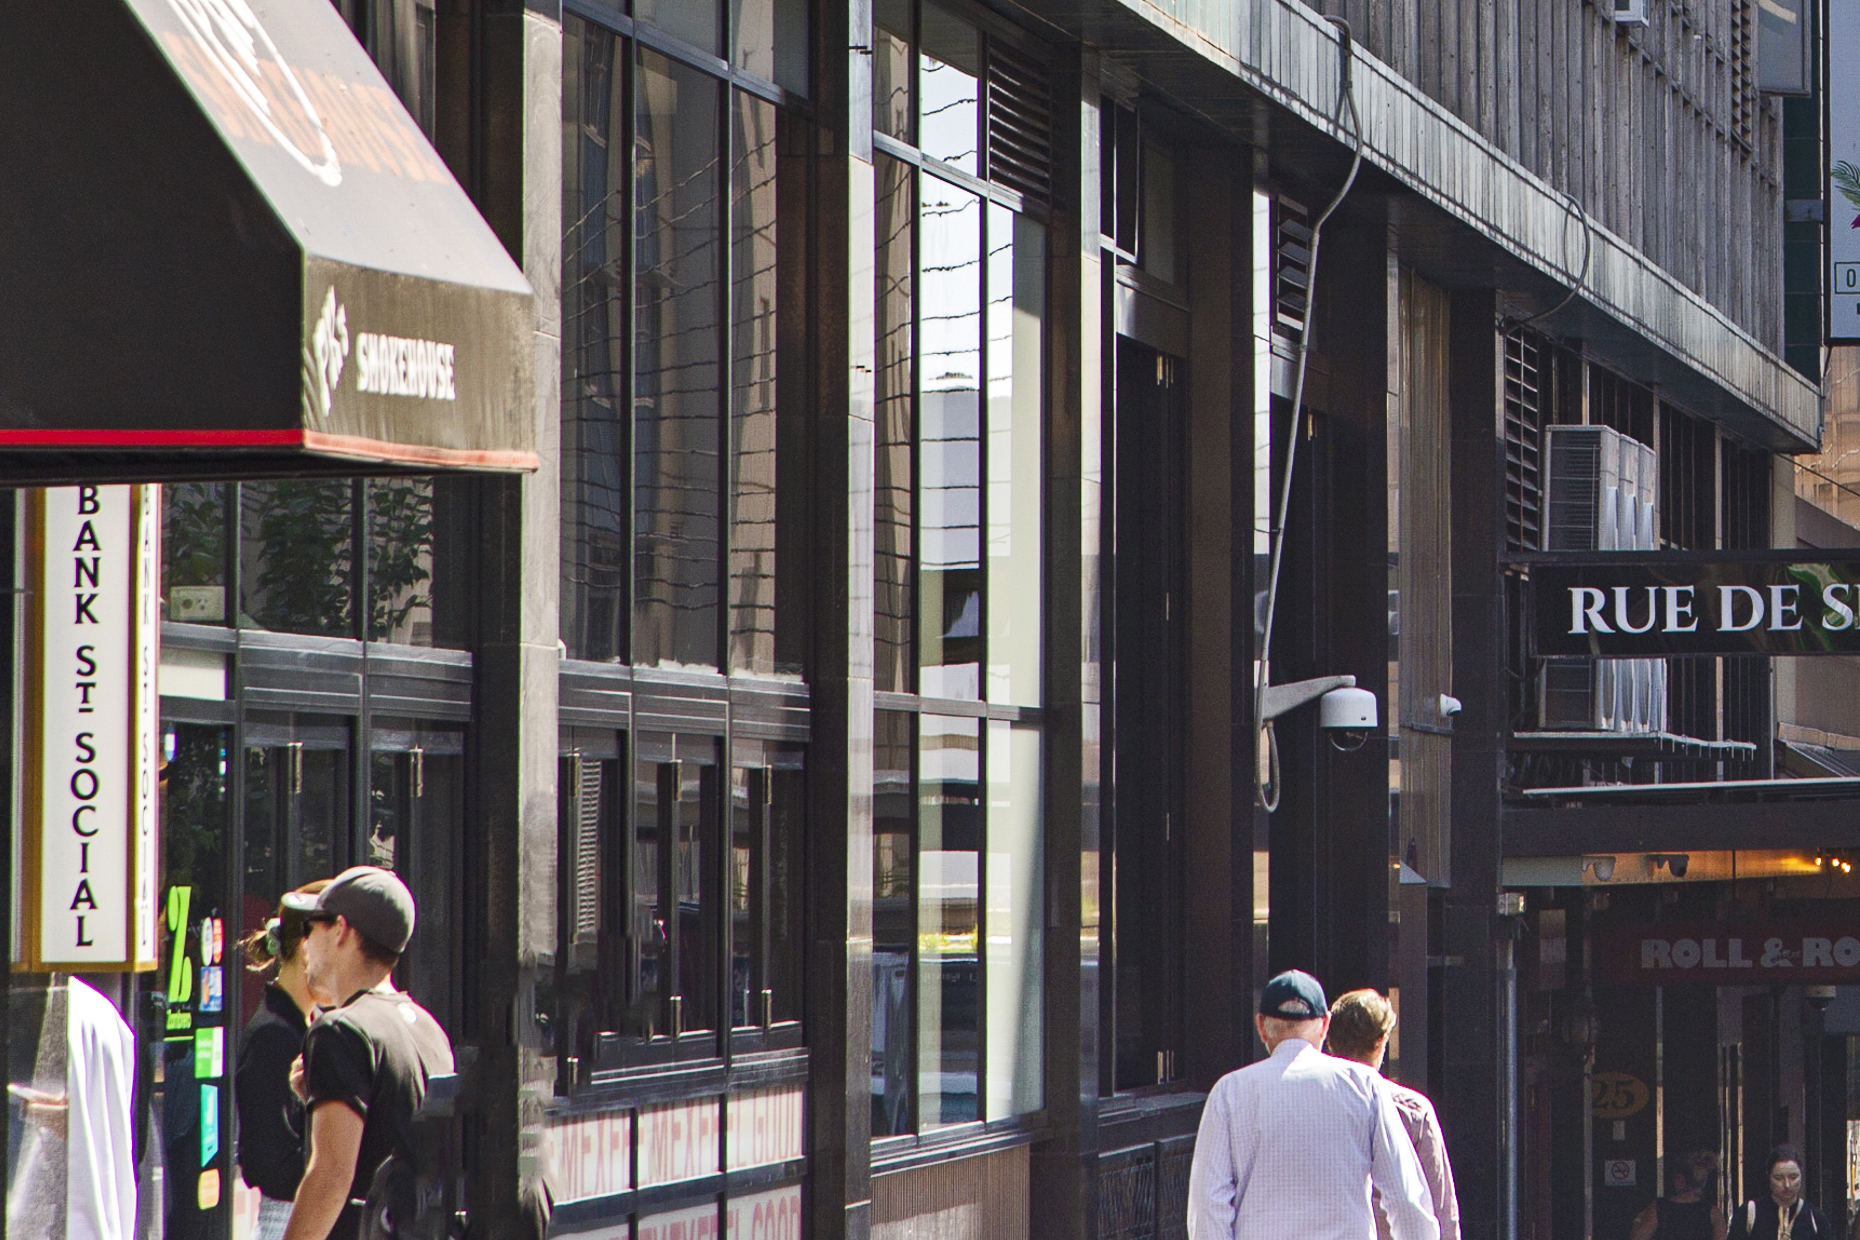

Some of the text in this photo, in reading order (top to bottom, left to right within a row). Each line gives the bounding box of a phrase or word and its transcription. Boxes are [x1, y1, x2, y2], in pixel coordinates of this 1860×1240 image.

[356, 331, 456, 401] SMOKEHOUSE
[73, 486, 101, 625] BANK
[1568, 585, 1699, 634] RUE
[1717, 584, 1804, 632] DE
[70, 732, 100, 948] SOCIAL
[1641, 938, 1753, 969] ROLL
[1760, 937, 1794, 969] &
[1592, 1080, 1636, 1109] 25
